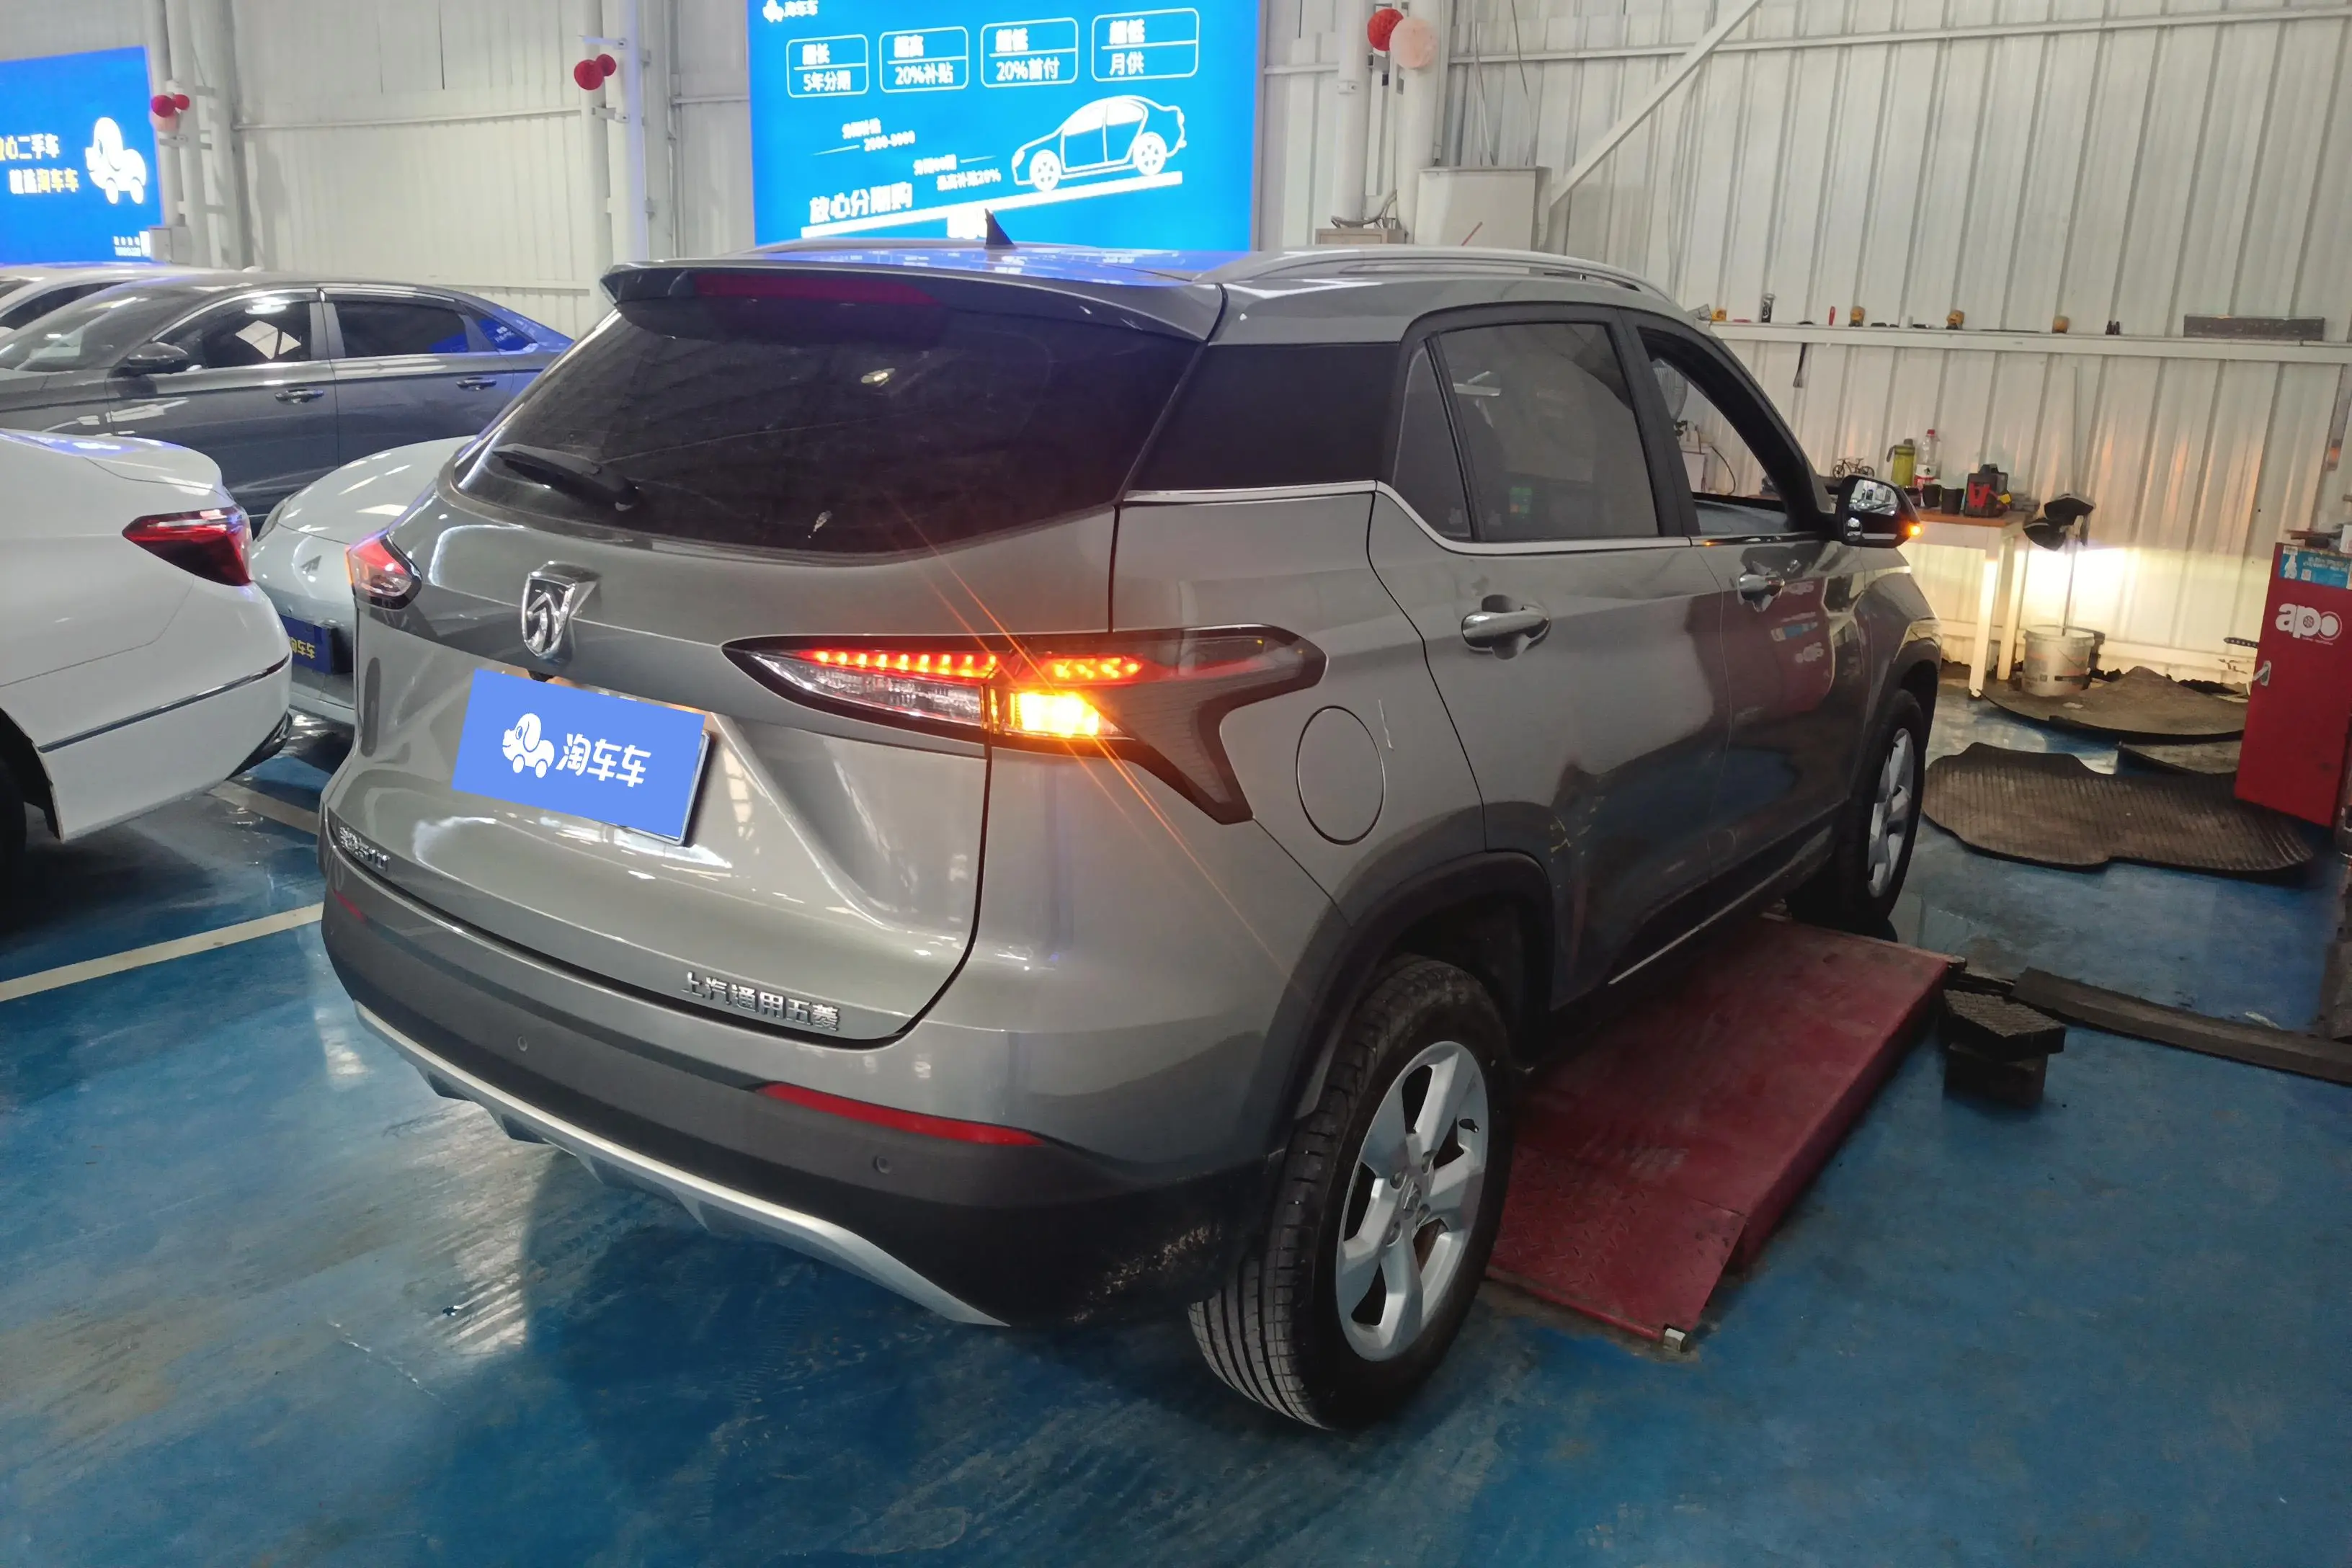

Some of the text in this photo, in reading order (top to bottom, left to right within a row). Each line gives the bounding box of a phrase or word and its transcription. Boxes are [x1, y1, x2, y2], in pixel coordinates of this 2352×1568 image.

[996, 57, 1060, 81] 20%首付
[1109, 51, 1144, 76] 月供
[681, 971, 839, 1031] 上汽通用五菱
